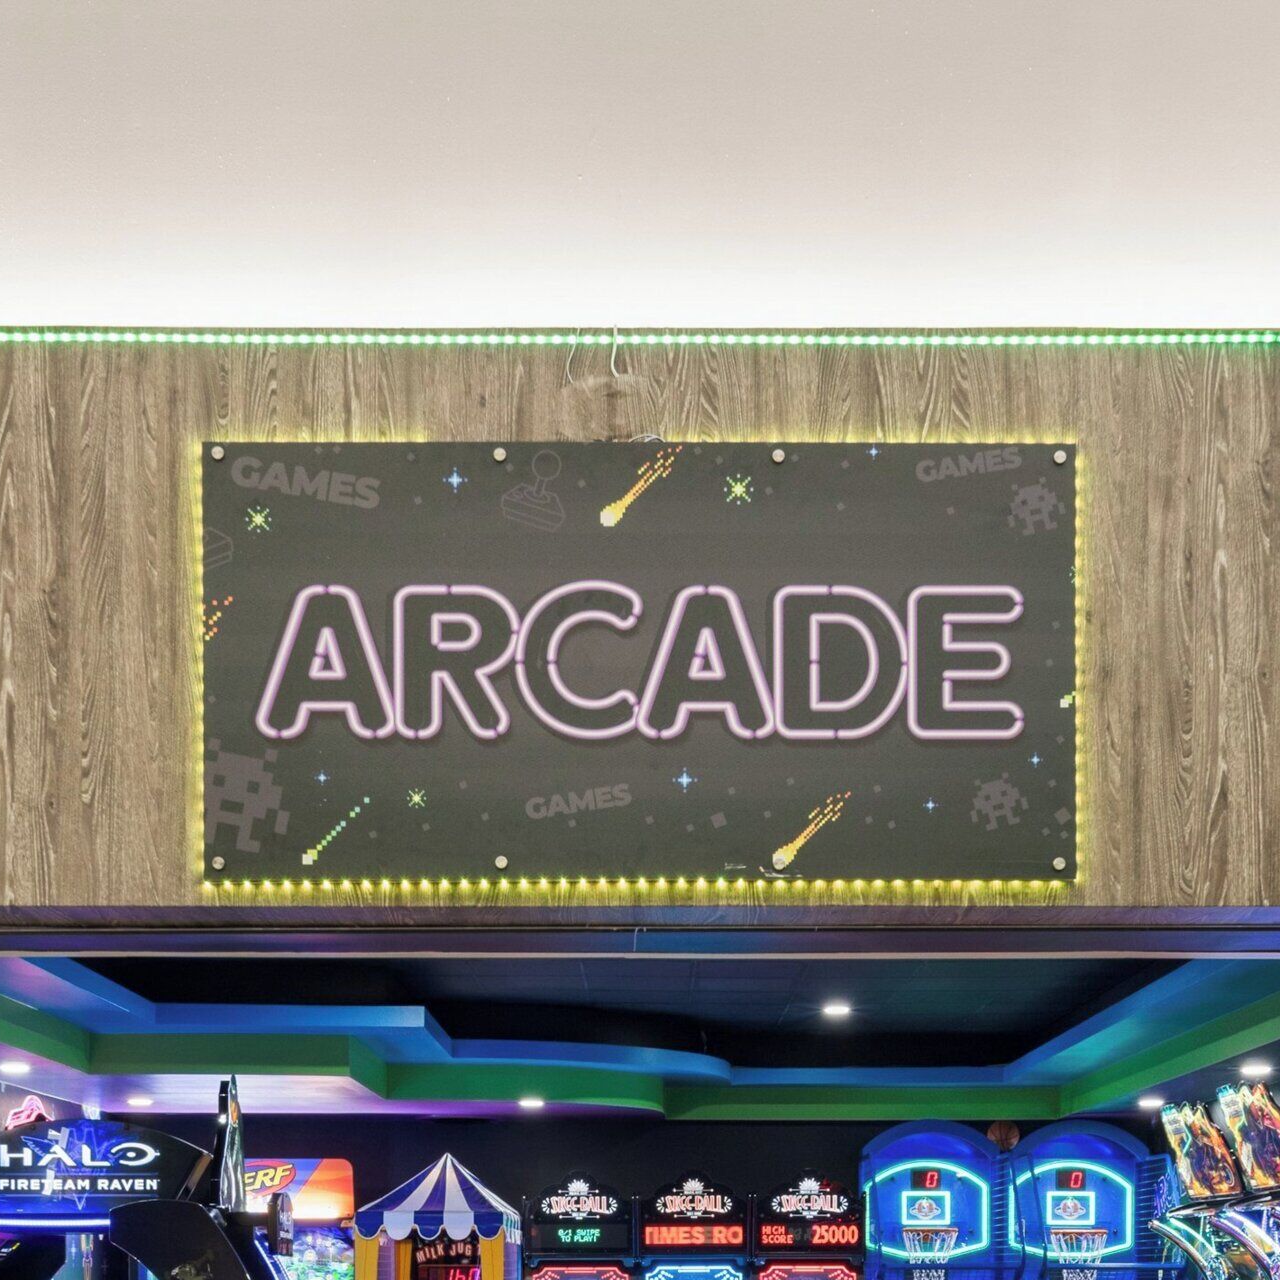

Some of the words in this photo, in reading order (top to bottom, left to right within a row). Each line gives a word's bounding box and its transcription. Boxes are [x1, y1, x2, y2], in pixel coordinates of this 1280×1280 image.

[915, 448, 1023, 484] GAMES
[230, 455, 382, 511] GAMES
[255, 579, 1026, 742] ARCADE
[524, 783, 633, 821] GAMES
[0, 1142, 160, 1167] HALO
[0, 1179, 90, 1191] FIRETEAM
[97, 1179, 158, 1191] RAVEN
[244, 1164, 293, 1191] ERF
[762, 1225, 785, 1235] HIGH
[762, 1234, 793, 1244] SCORE
[812, 1224, 858, 1244] 25000
[416, 1244, 445, 1263] MILK
[450, 1242, 472, 1256] JUG
